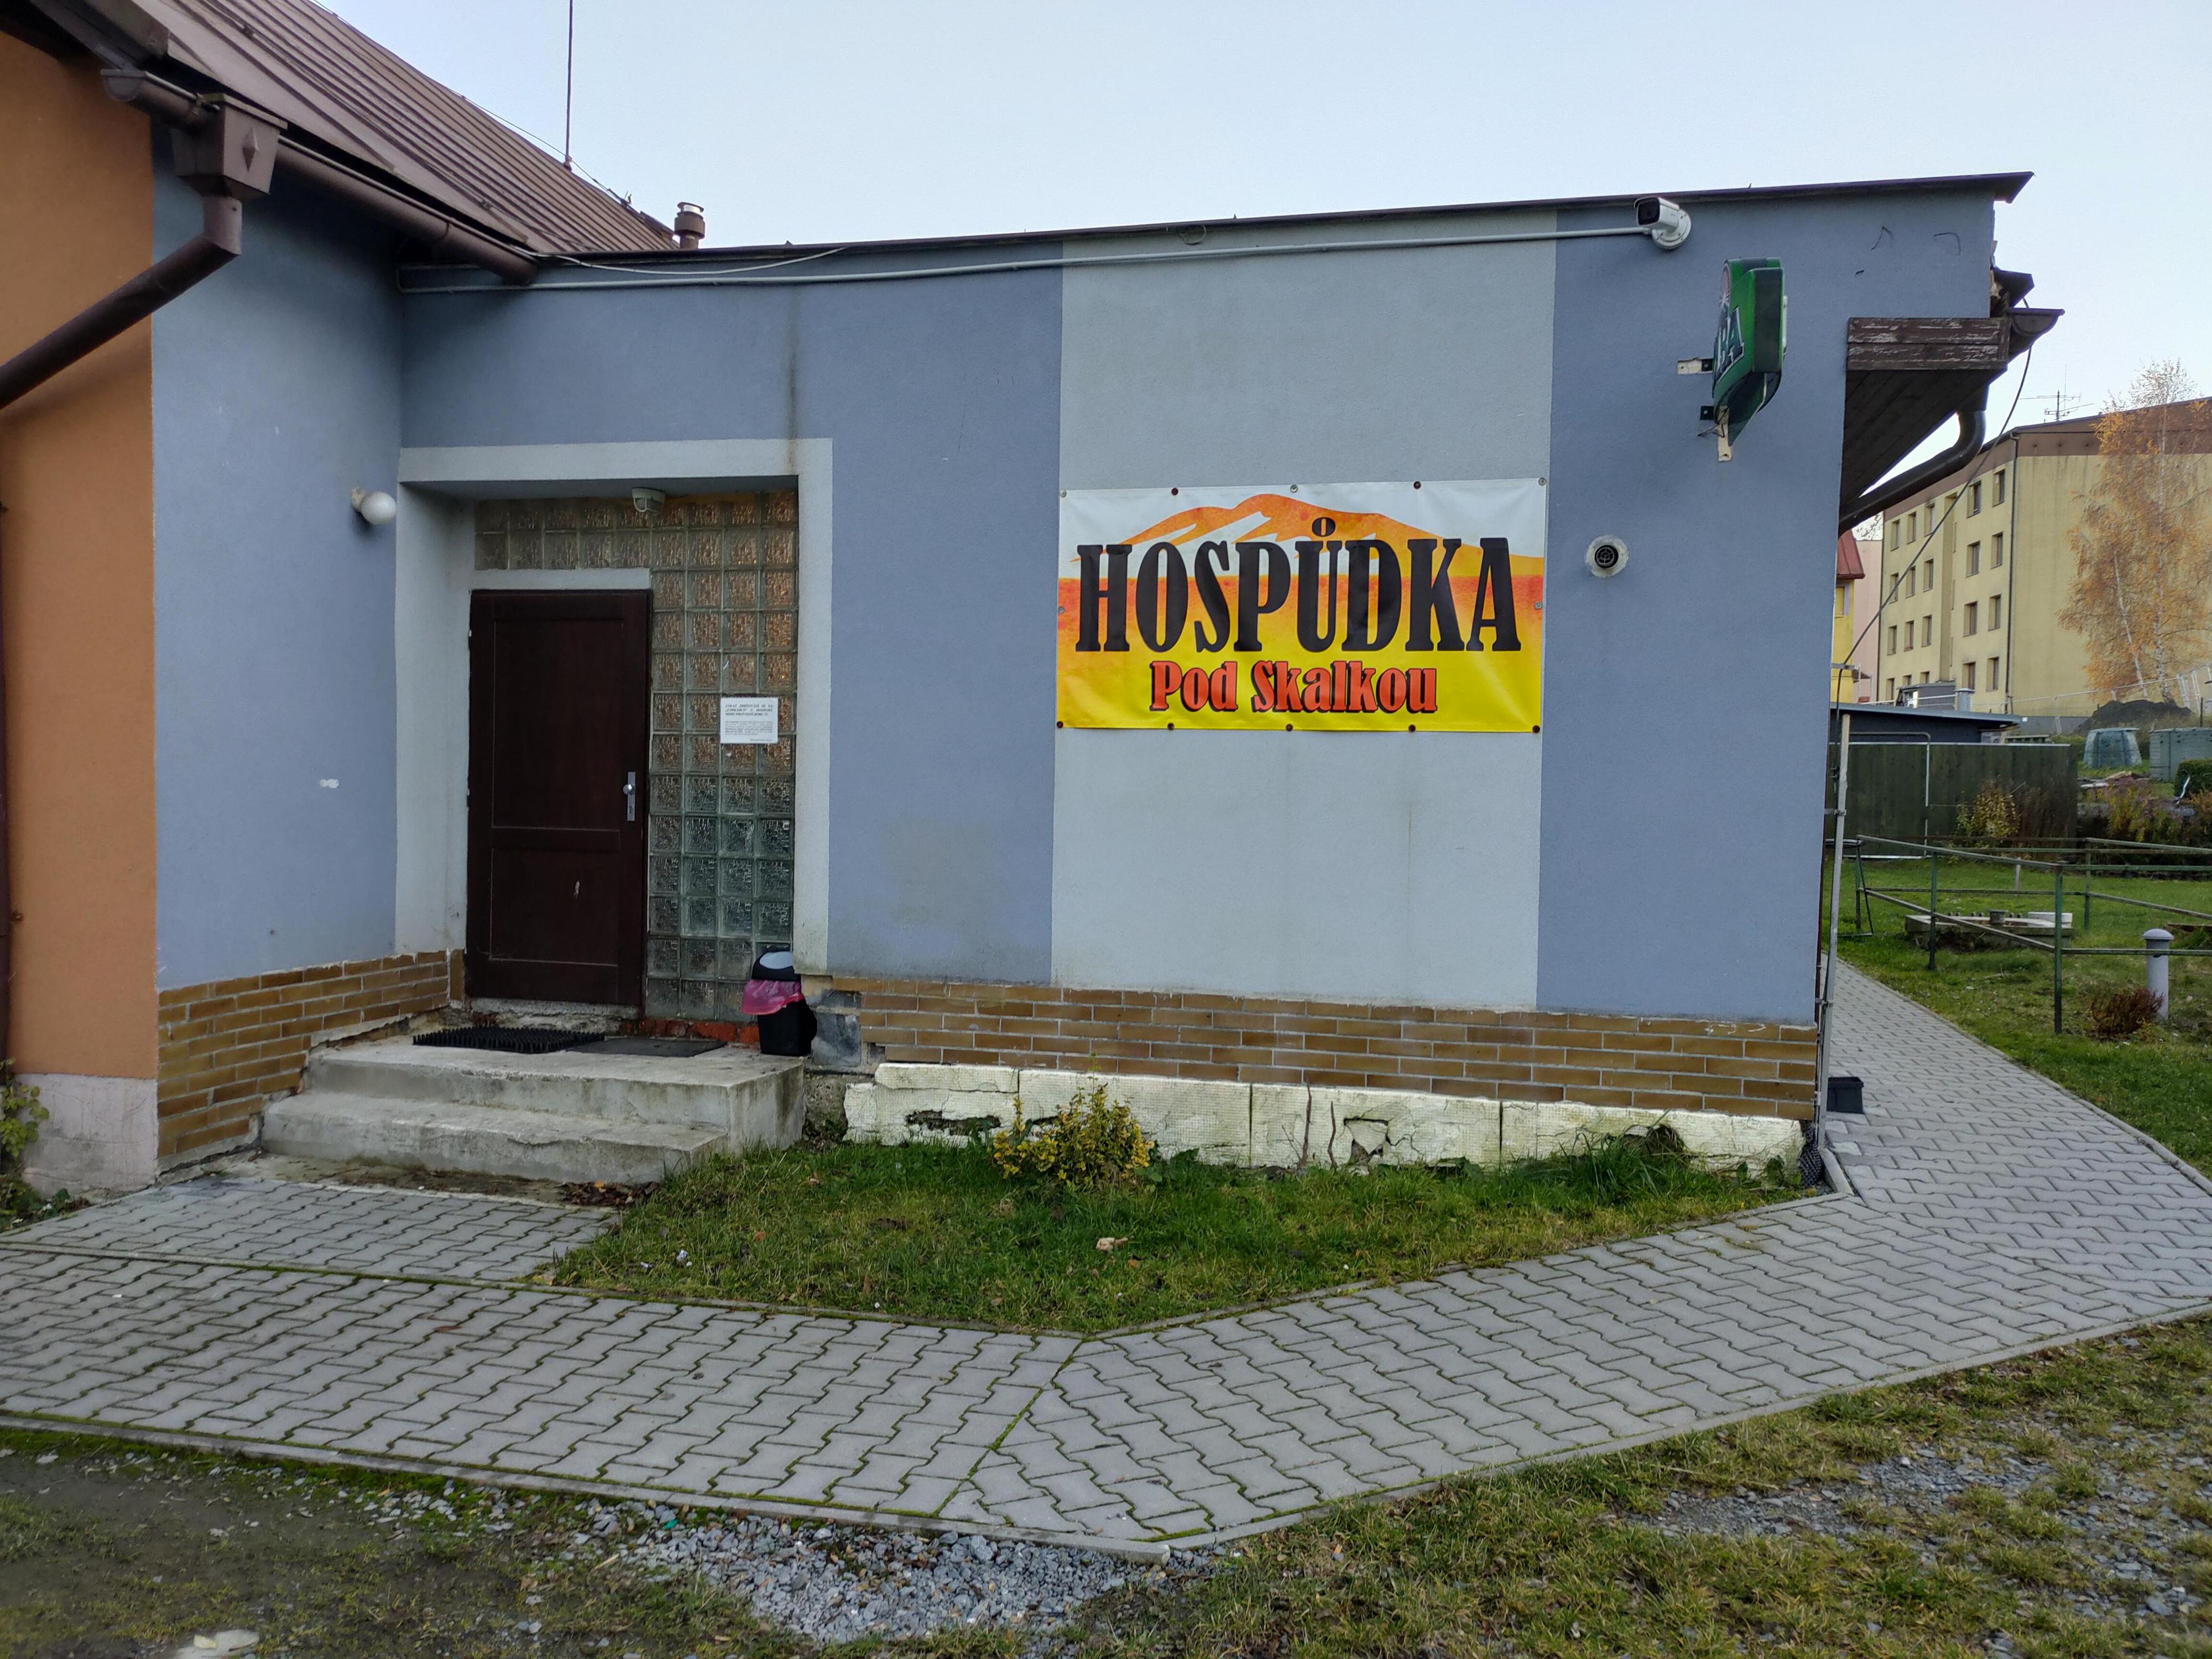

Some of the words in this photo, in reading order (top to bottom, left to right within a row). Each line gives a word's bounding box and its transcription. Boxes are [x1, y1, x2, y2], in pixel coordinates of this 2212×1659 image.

[1075, 517, 1521, 653] HOSPŮDKA
[1149, 660, 1238, 712] Pod
[1251, 660, 1437, 713] Skalkou
